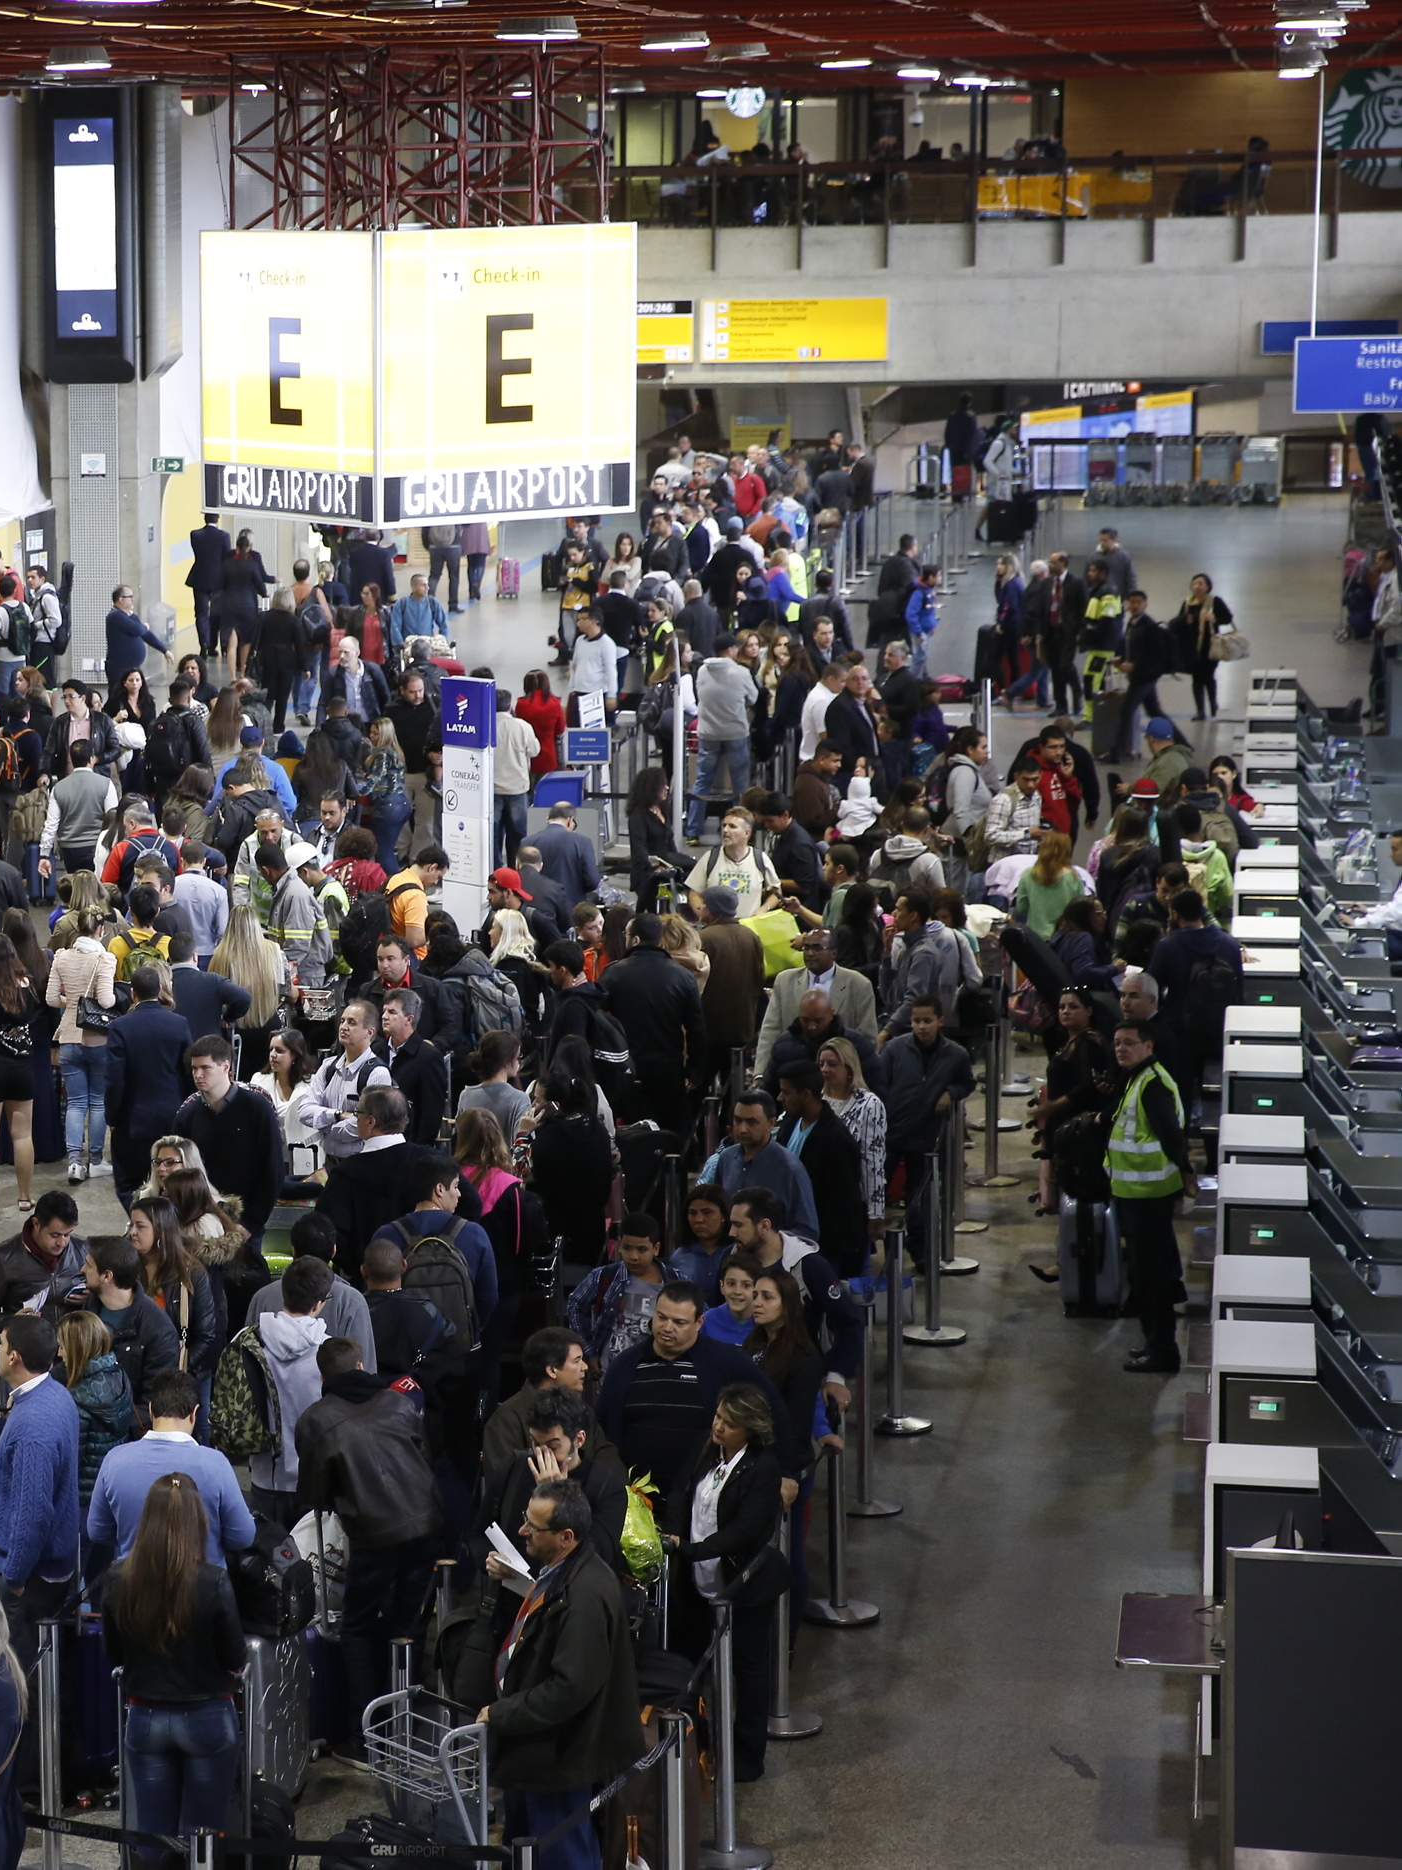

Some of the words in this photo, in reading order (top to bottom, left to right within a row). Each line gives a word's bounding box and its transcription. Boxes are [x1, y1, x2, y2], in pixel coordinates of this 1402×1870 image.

[259, 269, 306, 287] Check-in
[473, 267, 541, 285] Check-in
[268, 316, 303, 427] E
[485, 313, 534, 425] E
[1364, 392, 1398, 408] Baby
[446, 722, 476, 735] LATAM
[451, 768, 481, 782] CONEXÃO
[454, 780, 481, 792] TRANSFER
